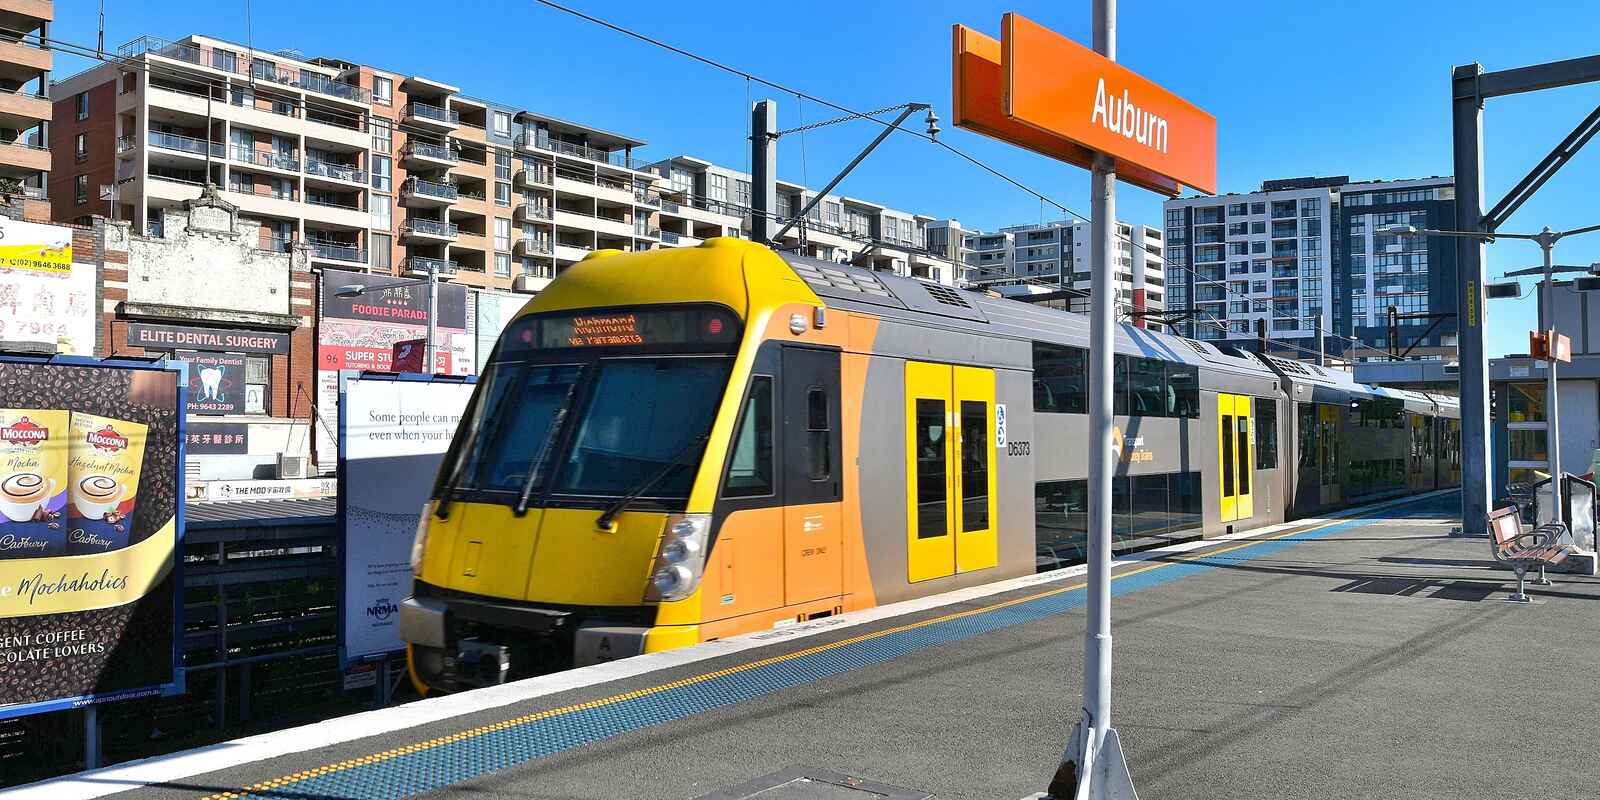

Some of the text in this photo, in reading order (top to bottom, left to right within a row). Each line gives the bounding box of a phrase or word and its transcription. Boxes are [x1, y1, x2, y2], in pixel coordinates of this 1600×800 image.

[1091, 77, 1169, 154] Auburn
[53, 262, 71, 271] 3688
[352, 304, 428, 320] FOODIE PARADI
[140, 330, 278, 349] ELITE DENTAL SURGERY
[179, 355, 243, 366] Your Family Dentist
[326, 354, 338, 364] 96
[345, 350, 375, 361] SUPER
[199, 403, 217, 411] 9643
[217, 403, 234, 411] 2289
[369, 409, 396, 423] Some
[399, 410, 431, 426] people
[432, 414, 448, 423] can
[2, 428, 47, 440] MOCCONA
[88, 433, 126, 448] MOCCONA
[368, 431, 392, 441] even
[394, 428, 420, 441] when
[422, 431, 444, 444] your
[1008, 441, 1031, 457] D6373
[7, 456, 40, 471] Mocha
[71, 456, 135, 476] Hazelnut Mocha
[235, 487, 249, 495] THE
[0, 533, 49, 551] Cadbury
[70, 528, 113, 550] Cadbury
[17, 568, 129, 605] Mochaholics
[367, 603, 399, 617] NRMA
[35, 629, 86, 645] COFFEE
[54, 642, 105, 658] LOVERS
